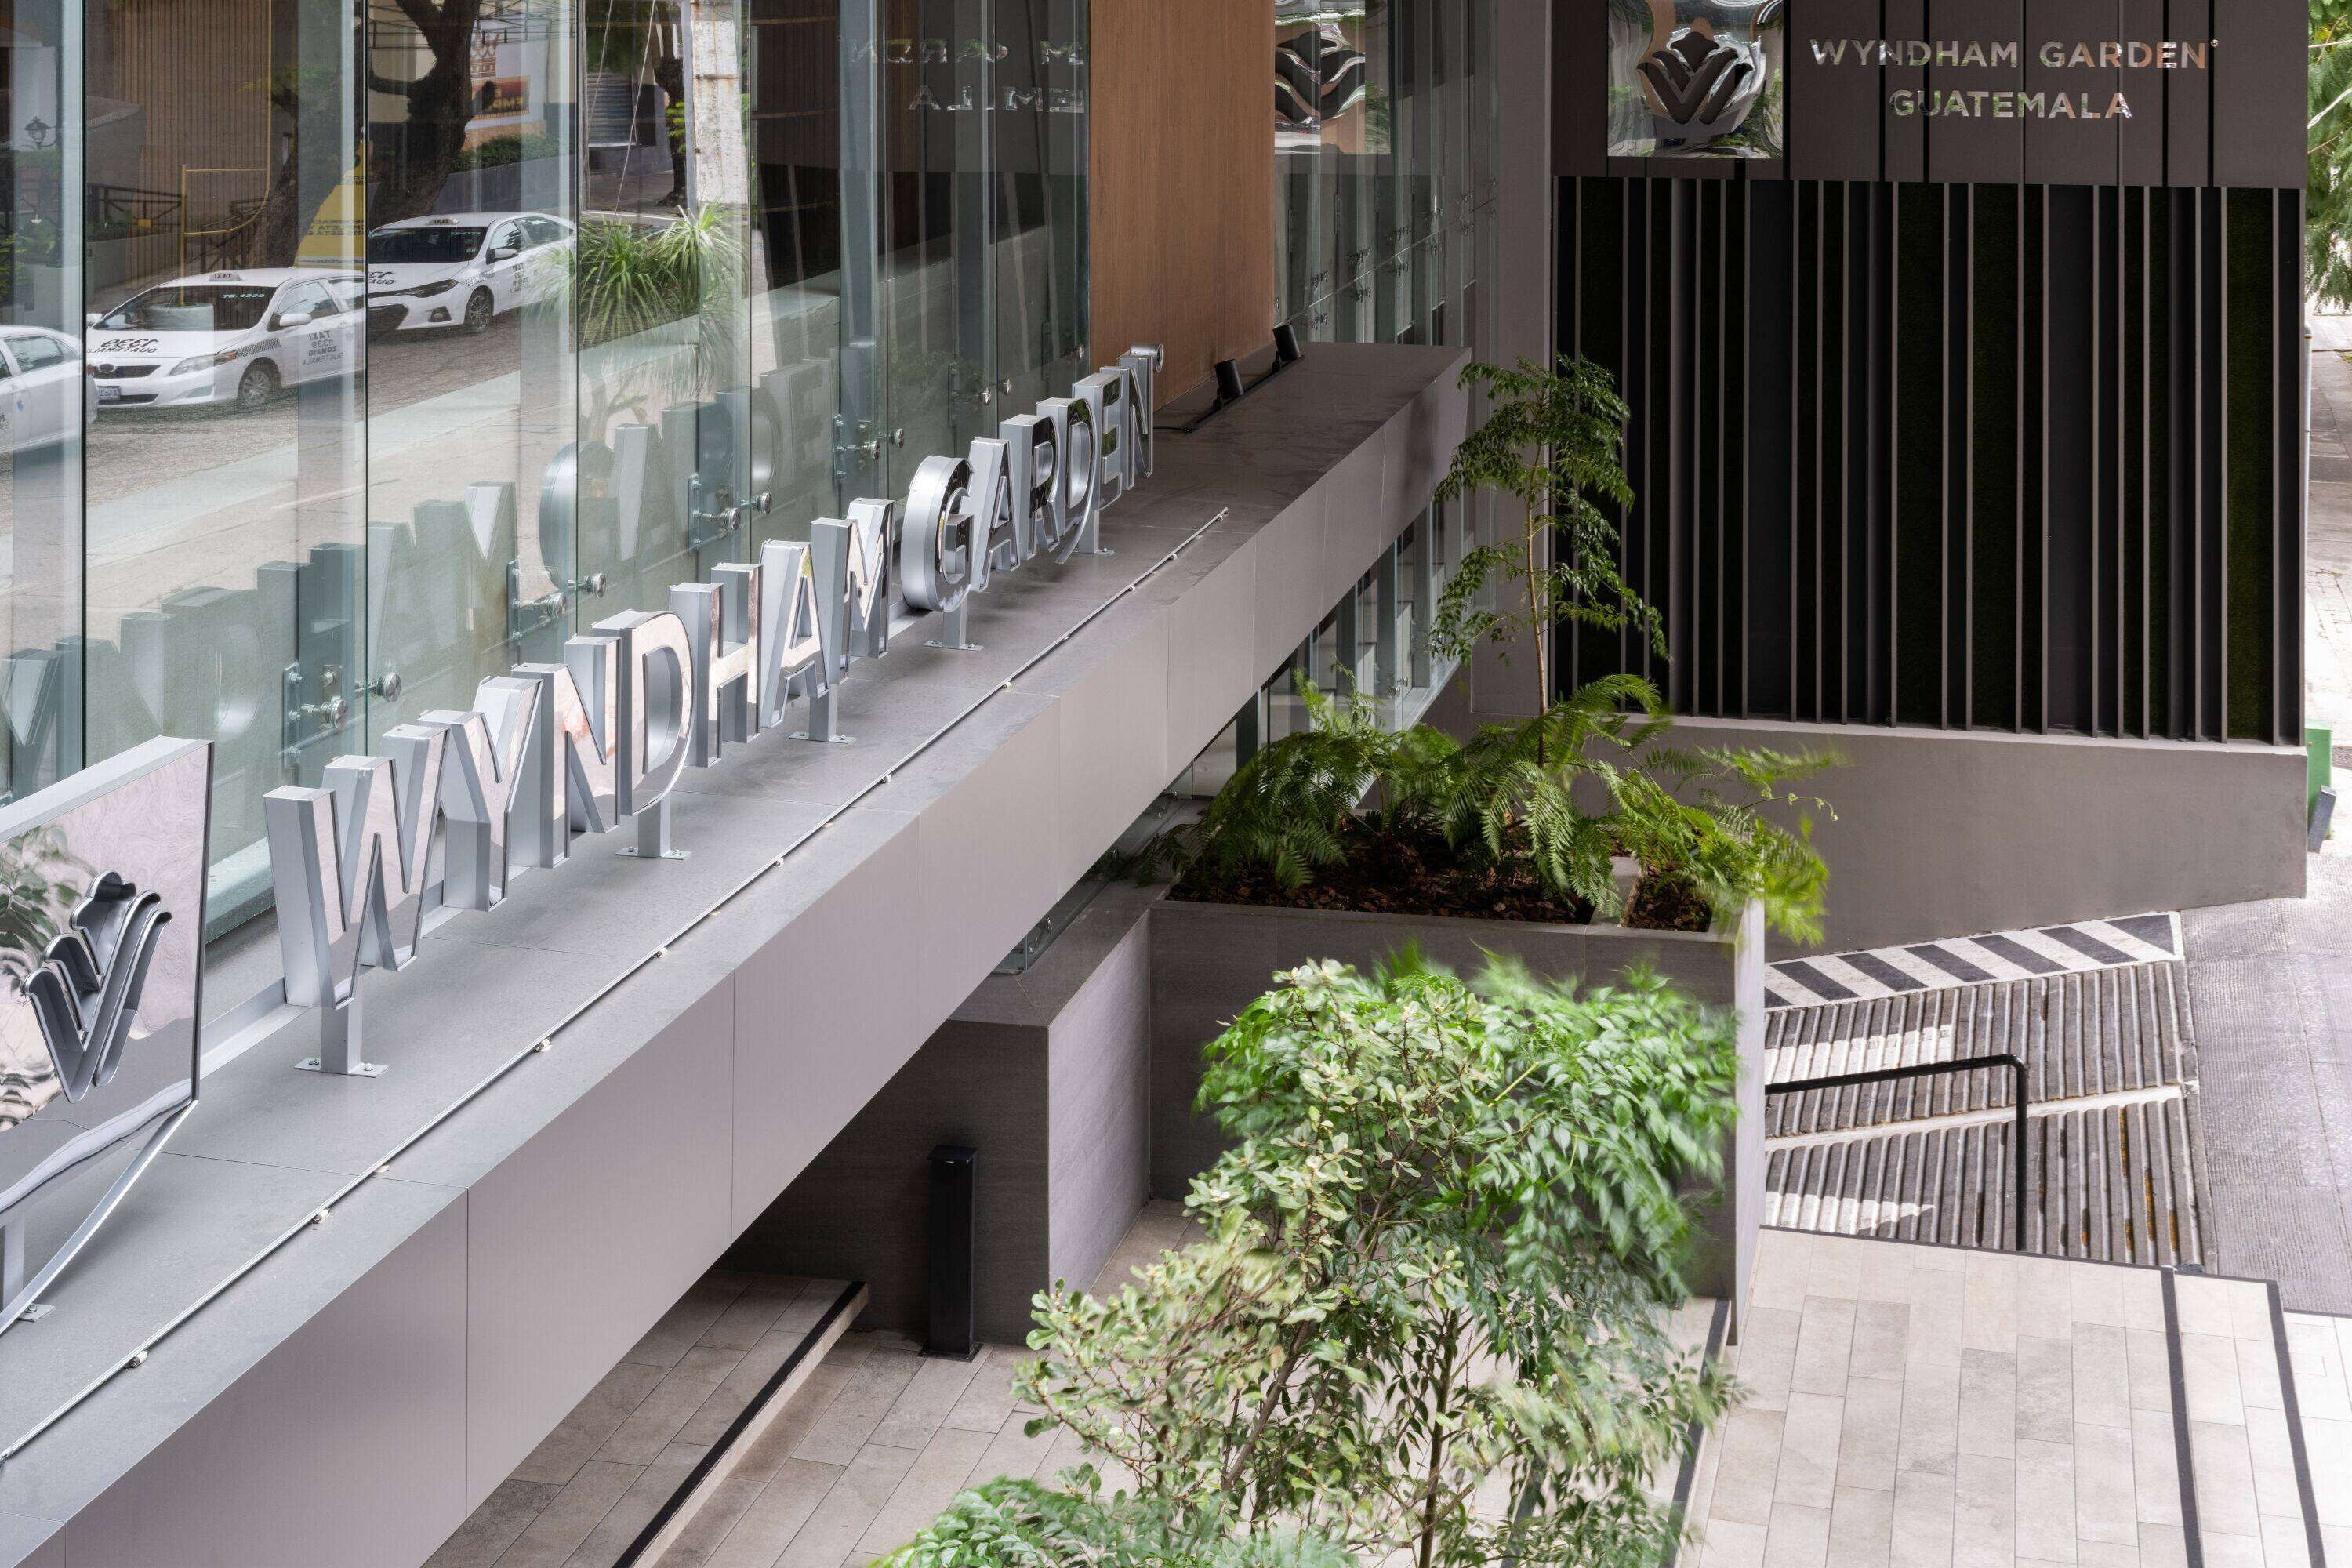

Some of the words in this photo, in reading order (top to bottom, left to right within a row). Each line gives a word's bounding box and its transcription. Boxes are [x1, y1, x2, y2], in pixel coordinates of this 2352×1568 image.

[1809, 38, 2019, 67] WYNDHAM
[1889, 89, 2133, 120] GUATEMALA
[263, 497, 895, 1009] WYNDHAM
